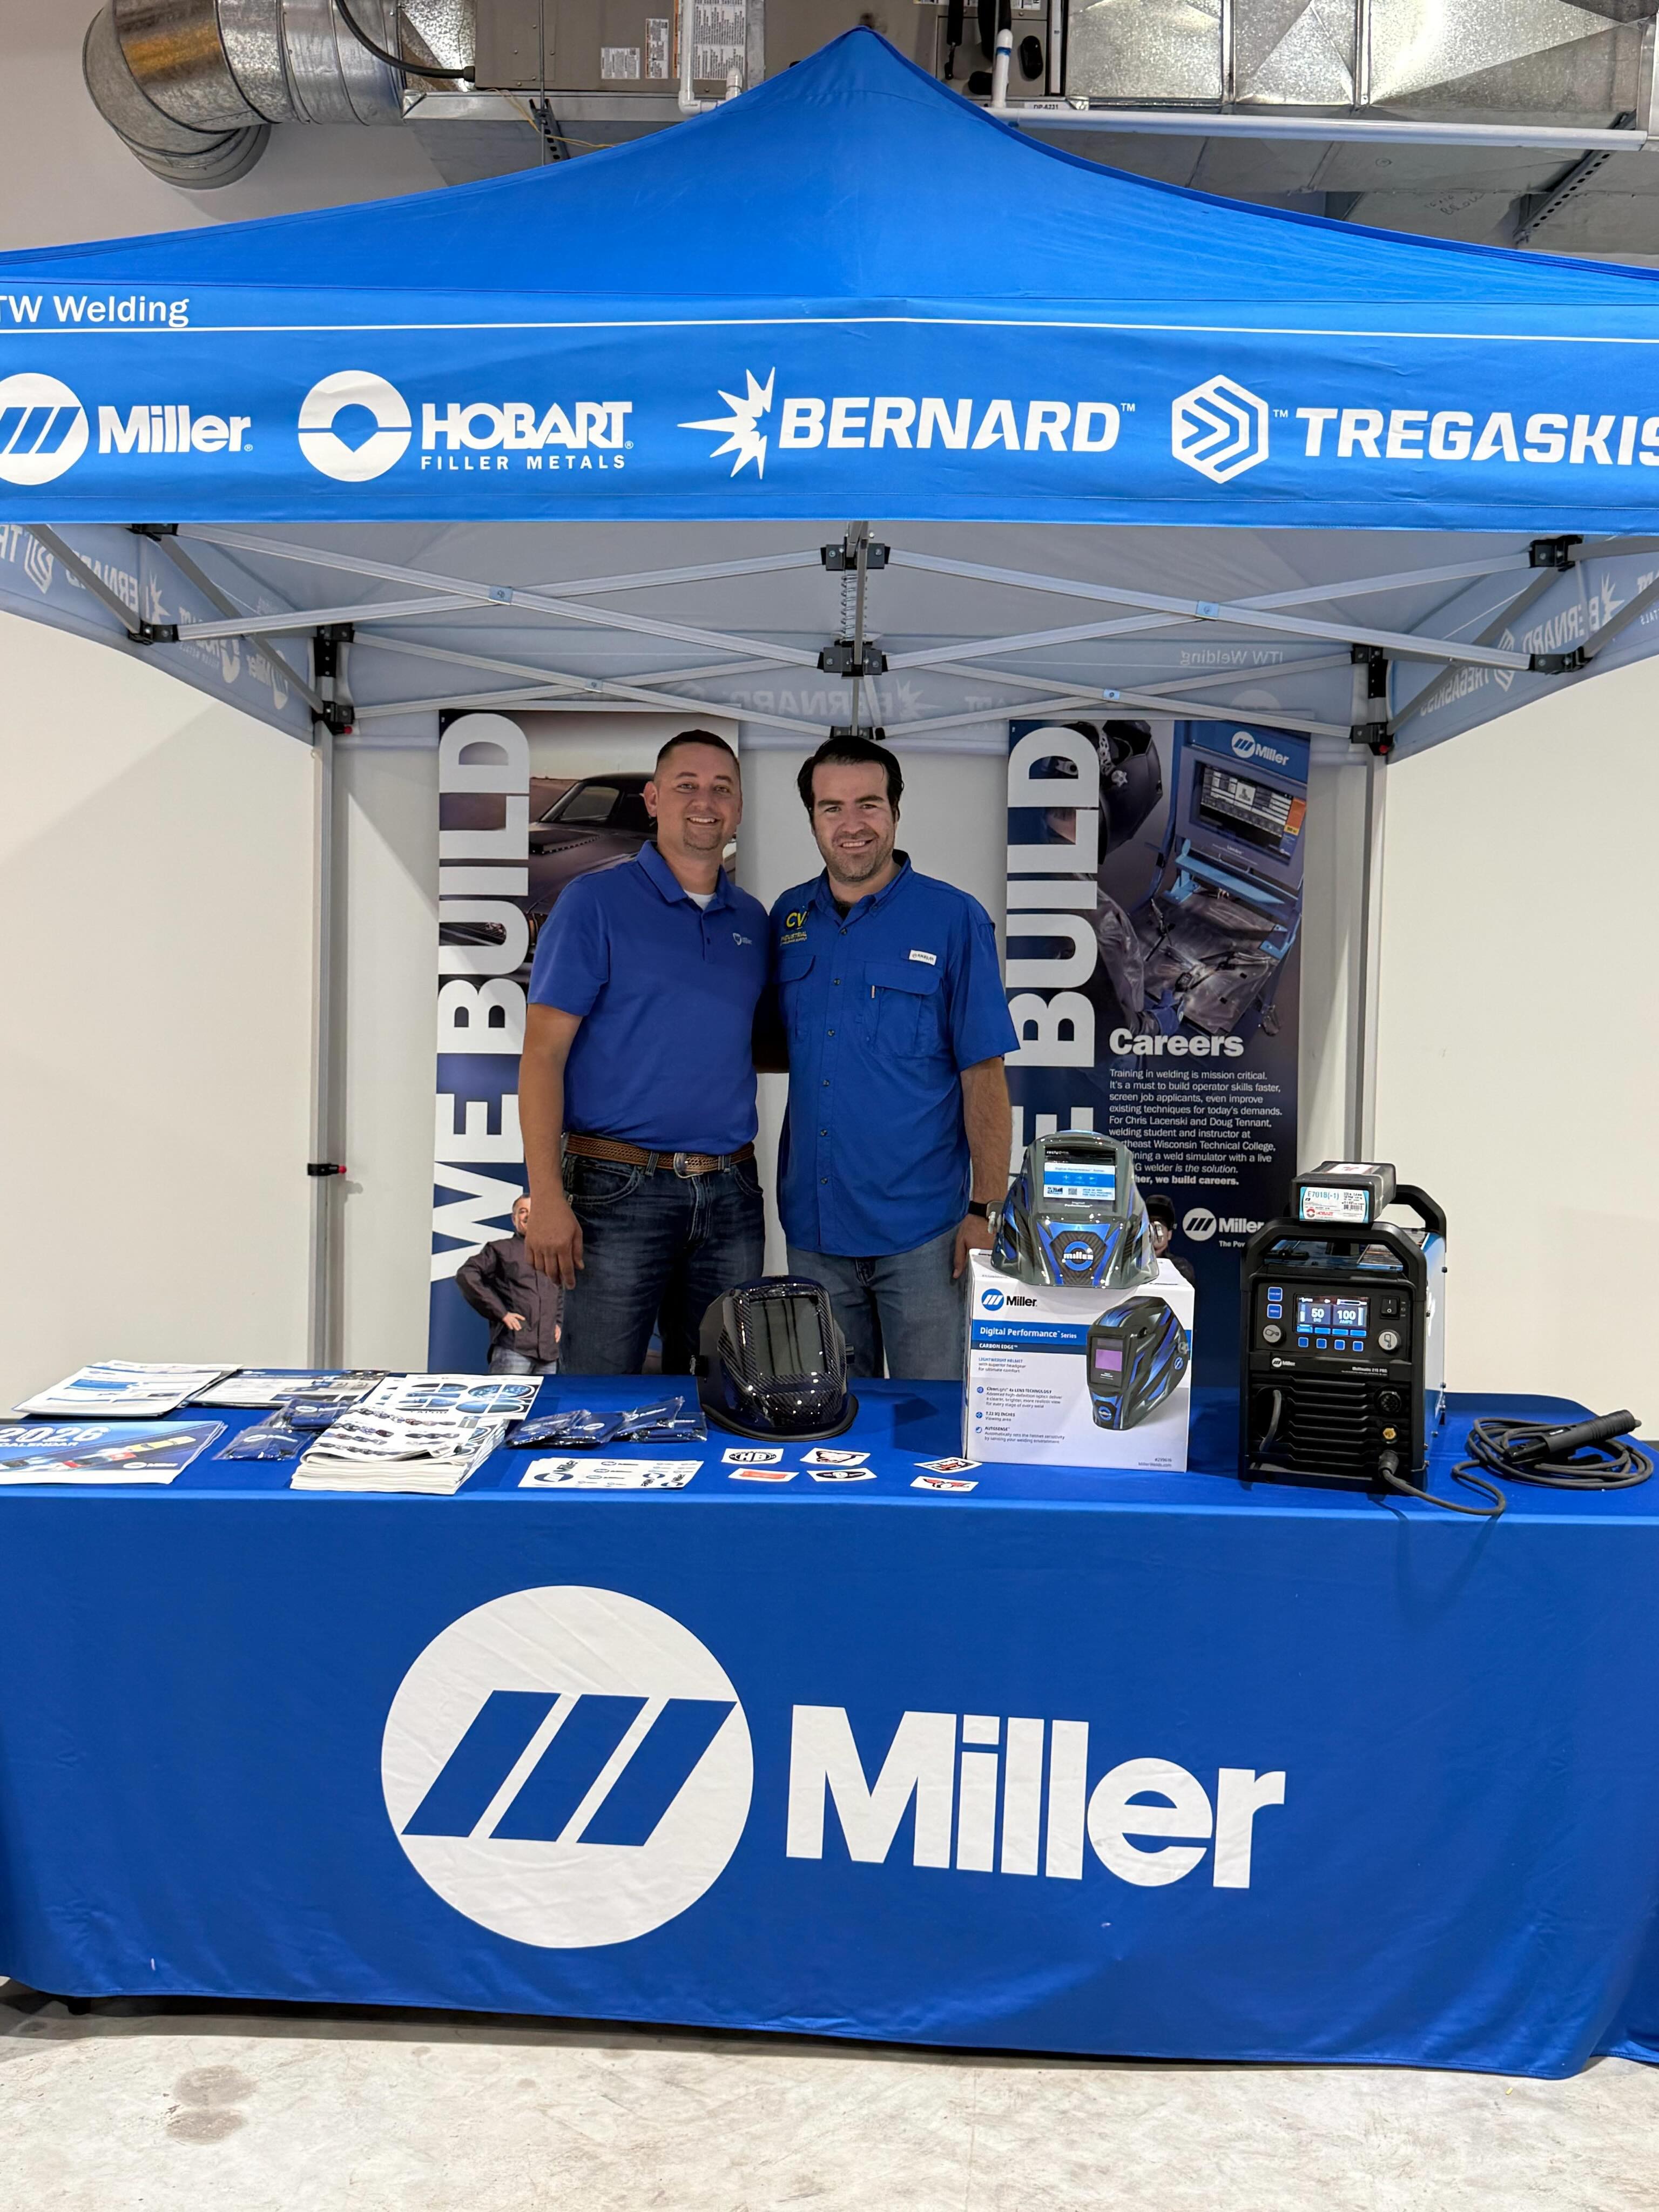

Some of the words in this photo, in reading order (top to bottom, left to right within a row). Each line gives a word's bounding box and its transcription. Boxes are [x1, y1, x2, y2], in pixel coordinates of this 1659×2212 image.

[53, 295, 189, 328] Welding
[421, 456, 509, 470] FILLER
[527, 455, 625, 469] METALS
[1255, 744, 1290, 765] Miller
[436, 713, 529, 1054] BUILD
[1003, 727, 1100, 1067] BUILD
[786, 911, 807, 927] CV
[1109, 1028, 1244, 1057] Careers
[1110, 1069, 1143, 1079] Training
[1156, 1070, 1189, 1080] welding
[1191, 1070, 1198, 1078] is
[1202, 1071, 1235, 1079] mission
[1237, 1071, 1267, 1080] critical.
[1169, 1082, 1189, 1090] build
[1192, 1083, 1229, 1092] operator
[1231, 1083, 1253, 1091] skills
[1256, 1083, 1280, 1092] faster,
[1139, 1094, 1154, 1102] job
[1156, 1094, 1203, 1103] applicants,
[1229, 1095, 1263, 1104] improve
[1109, 1105, 1142, 1114] existing
[1144, 1105, 1191, 1115] techniques
[1193, 1105, 1205, 1114] for
[1208, 1106, 1238, 1116] today's
[1240, 1107, 1282, 1115] demands.
[1109, 1116, 1123, 1124] For
[1125, 1116, 1147, 1124] Chris
[1150, 1116, 1188, 1125] Lacenski
[1190, 1117, 1206, 1125] and
[1210, 1117, 1232, 1128] Doug
[1109, 1128, 1142, 1137] welding
[1144, 1128, 1176, 1137] student
[1179, 1129, 1196, 1137] and
[1198, 1129, 1239, 1138] instructor
[1242, 1130, 1251, 1138] at
[1122, 1139, 1151, 1148] theast
[1154, 1140, 1197, 1149] Wisconsin
[1199, 1141, 1240, 1150] Technical
[1242, 1142, 1276, 1152] College,
[1163, 1152, 1183, 1160] weld
[1186, 1152, 1226, 1161] simulator
[1229, 1153, 1247, 1162] with
[1258, 1154, 1271, 1162] live
[1145, 1163, 1173, 1172] welder
[1185, 1164, 1199, 1172] the
[1202, 1164, 1238, 1174] solution.
[1172, 1175, 1196, 1184] build
[430, 1093, 524, 1282] WE
[1219, 1217, 1264, 1232] Miller
[1006, 1296, 1037, 1306] Miller
[1311, 1308, 1324, 1318] 50
[1337, 1310, 1356, 1320] 100
[980, 1327, 1005, 1337] Digital
[0, 1427, 110, 1442] 2026
[786, 1704, 1286, 1889] Miller
